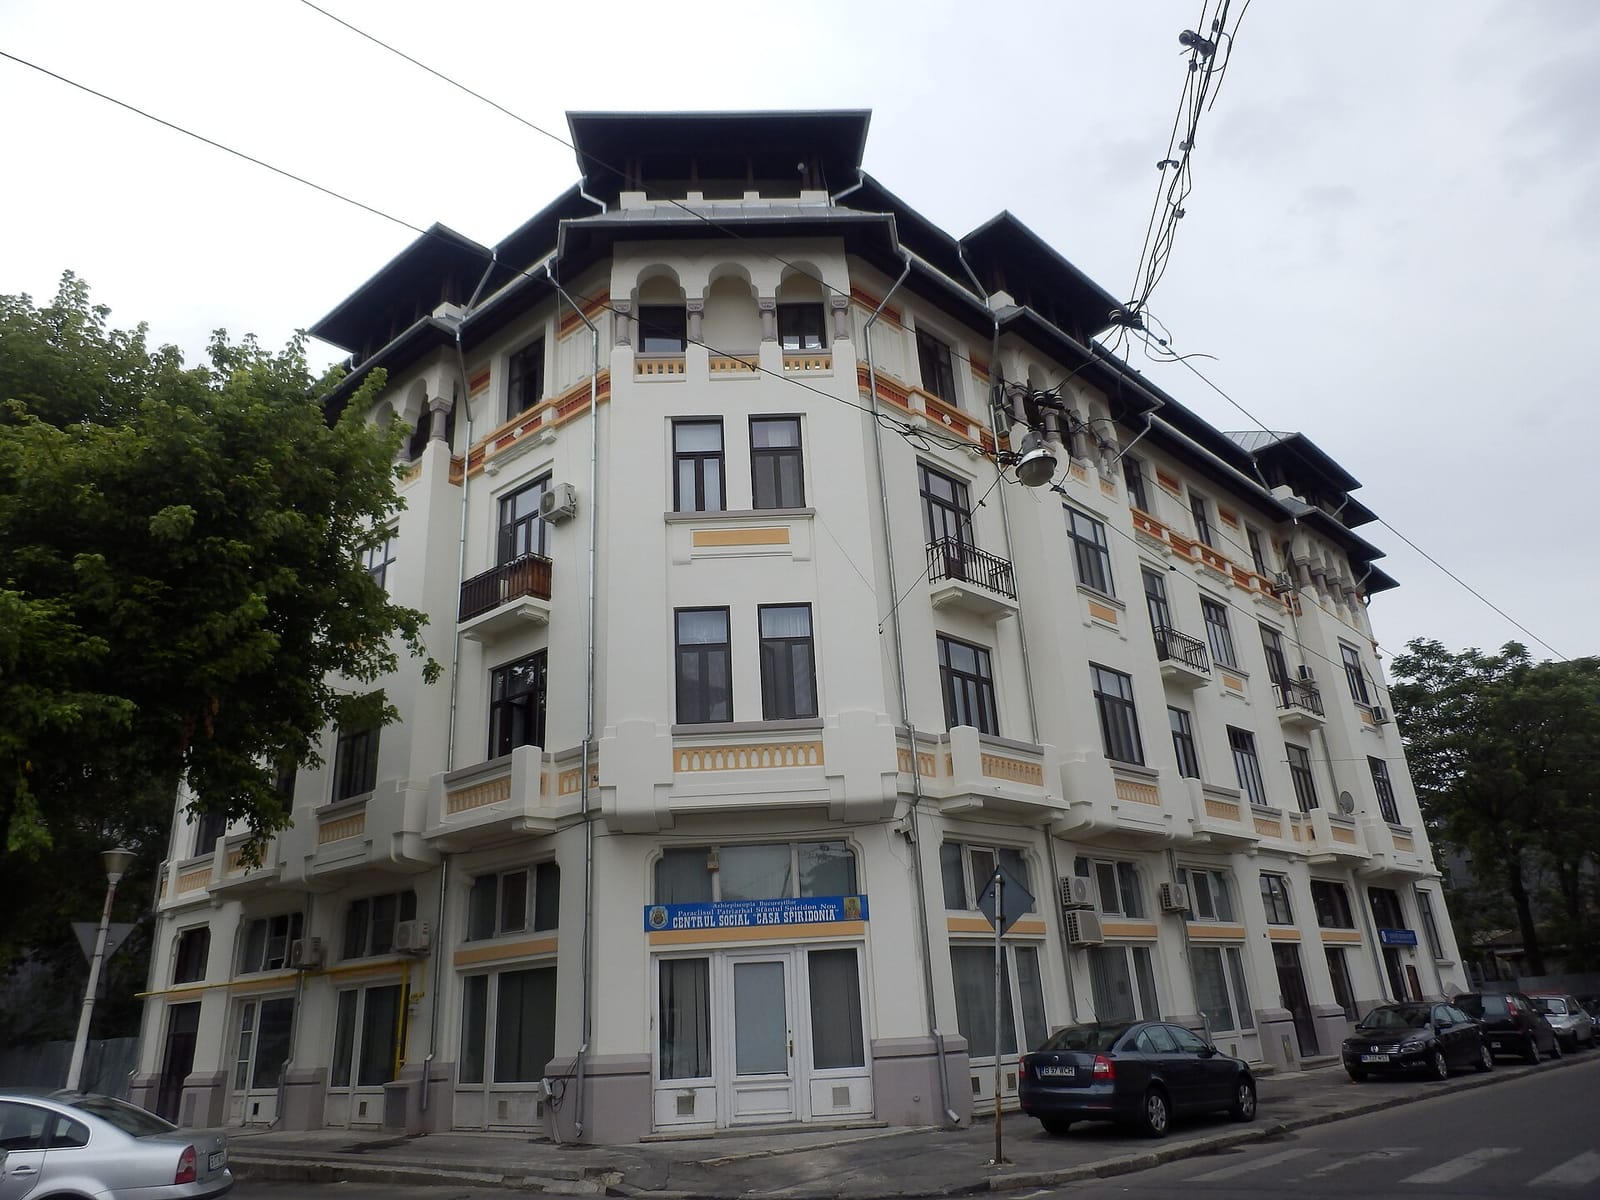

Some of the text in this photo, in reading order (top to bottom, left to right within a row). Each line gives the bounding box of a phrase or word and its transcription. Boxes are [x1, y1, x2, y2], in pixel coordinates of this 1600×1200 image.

[678, 909, 714, 917] Paraclisul
[717, 907, 753, 915] Patriarhal
[756, 905, 783, 913] Sfântul
[784, 904, 817, 912] Spiridon
[672, 909, 839, 929] CENTRUL SOCIAL "CASA SPIRIDONIA"
